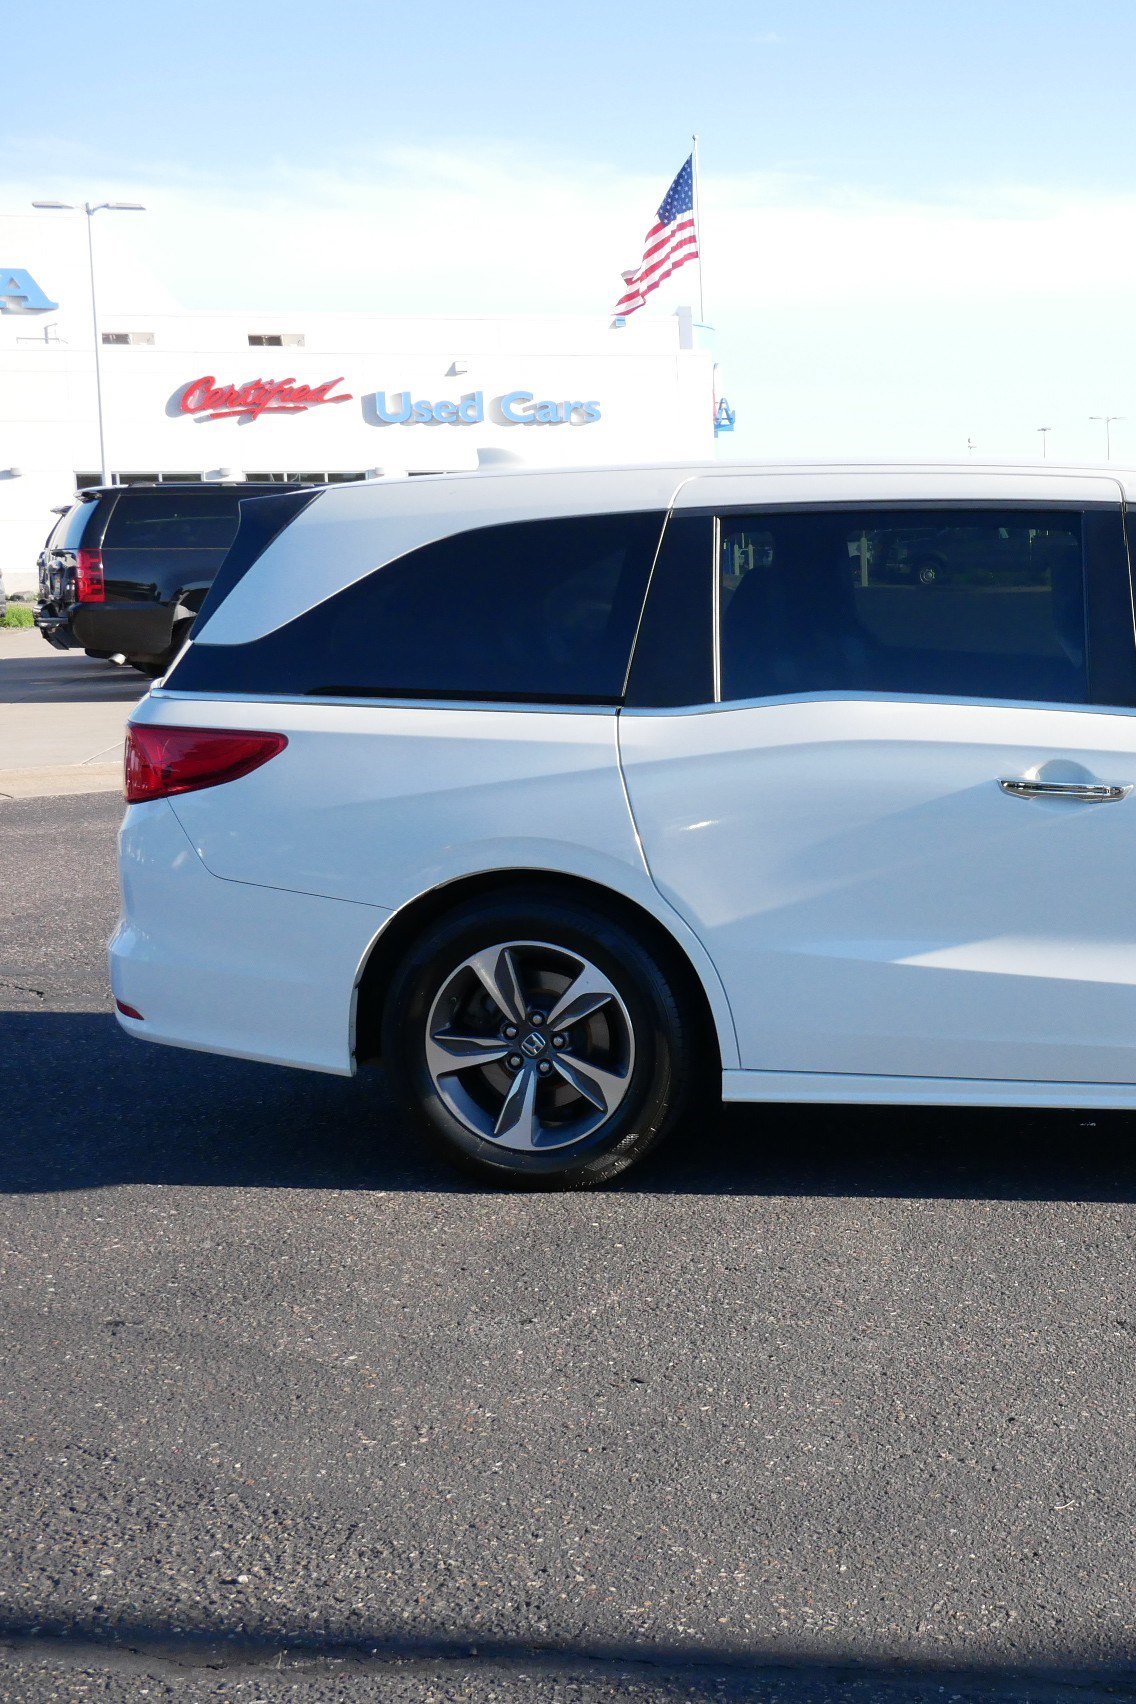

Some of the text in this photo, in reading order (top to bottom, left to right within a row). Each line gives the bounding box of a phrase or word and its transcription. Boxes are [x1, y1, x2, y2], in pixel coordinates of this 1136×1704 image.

[181, 376, 353, 420] Certified
[376, 391, 601, 422] Used Cars
